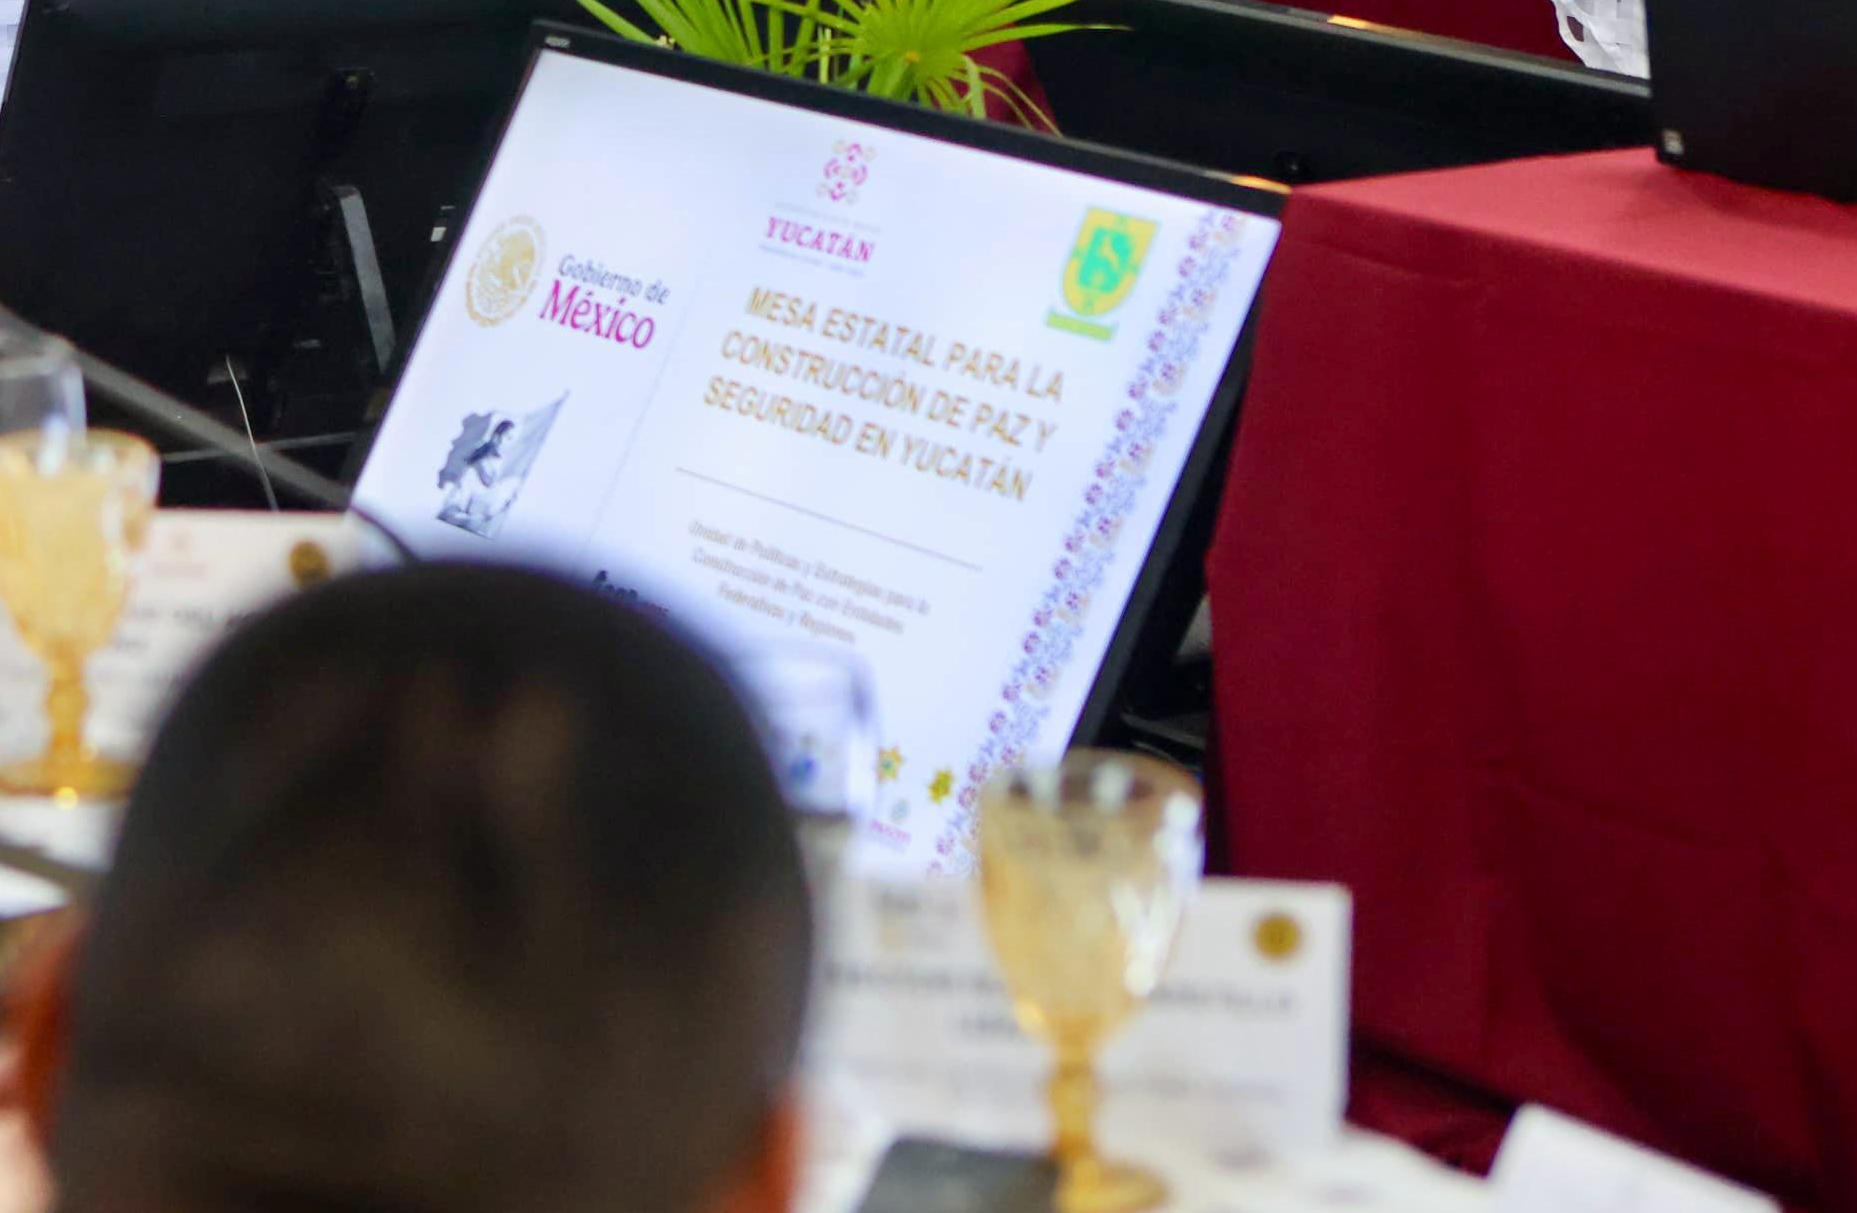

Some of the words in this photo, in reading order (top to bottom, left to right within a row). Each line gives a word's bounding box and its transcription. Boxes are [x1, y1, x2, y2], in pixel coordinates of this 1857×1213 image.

[558, 253, 643, 297] Gobierno
[644, 279, 671, 305] de
[765, 216, 877, 263] YUCATÁN
[539, 279, 656, 349] México
[746, 285, 818, 333] MESA
[821, 306, 939, 368] ESTATAL
[942, 341, 1023, 390] PARA
[1025, 364, 1066, 403] LA
[703, 374, 854, 447] SEGURIDAD
[855, 421, 898, 460] EN
[899, 433, 1034, 501] YUCATÁN
[720, 329, 927, 415] CONSTRUCCIÓN
[927, 389, 971, 429] DE
[970, 402, 1032, 448] PAZ
[1033, 420, 1057, 454] Y
